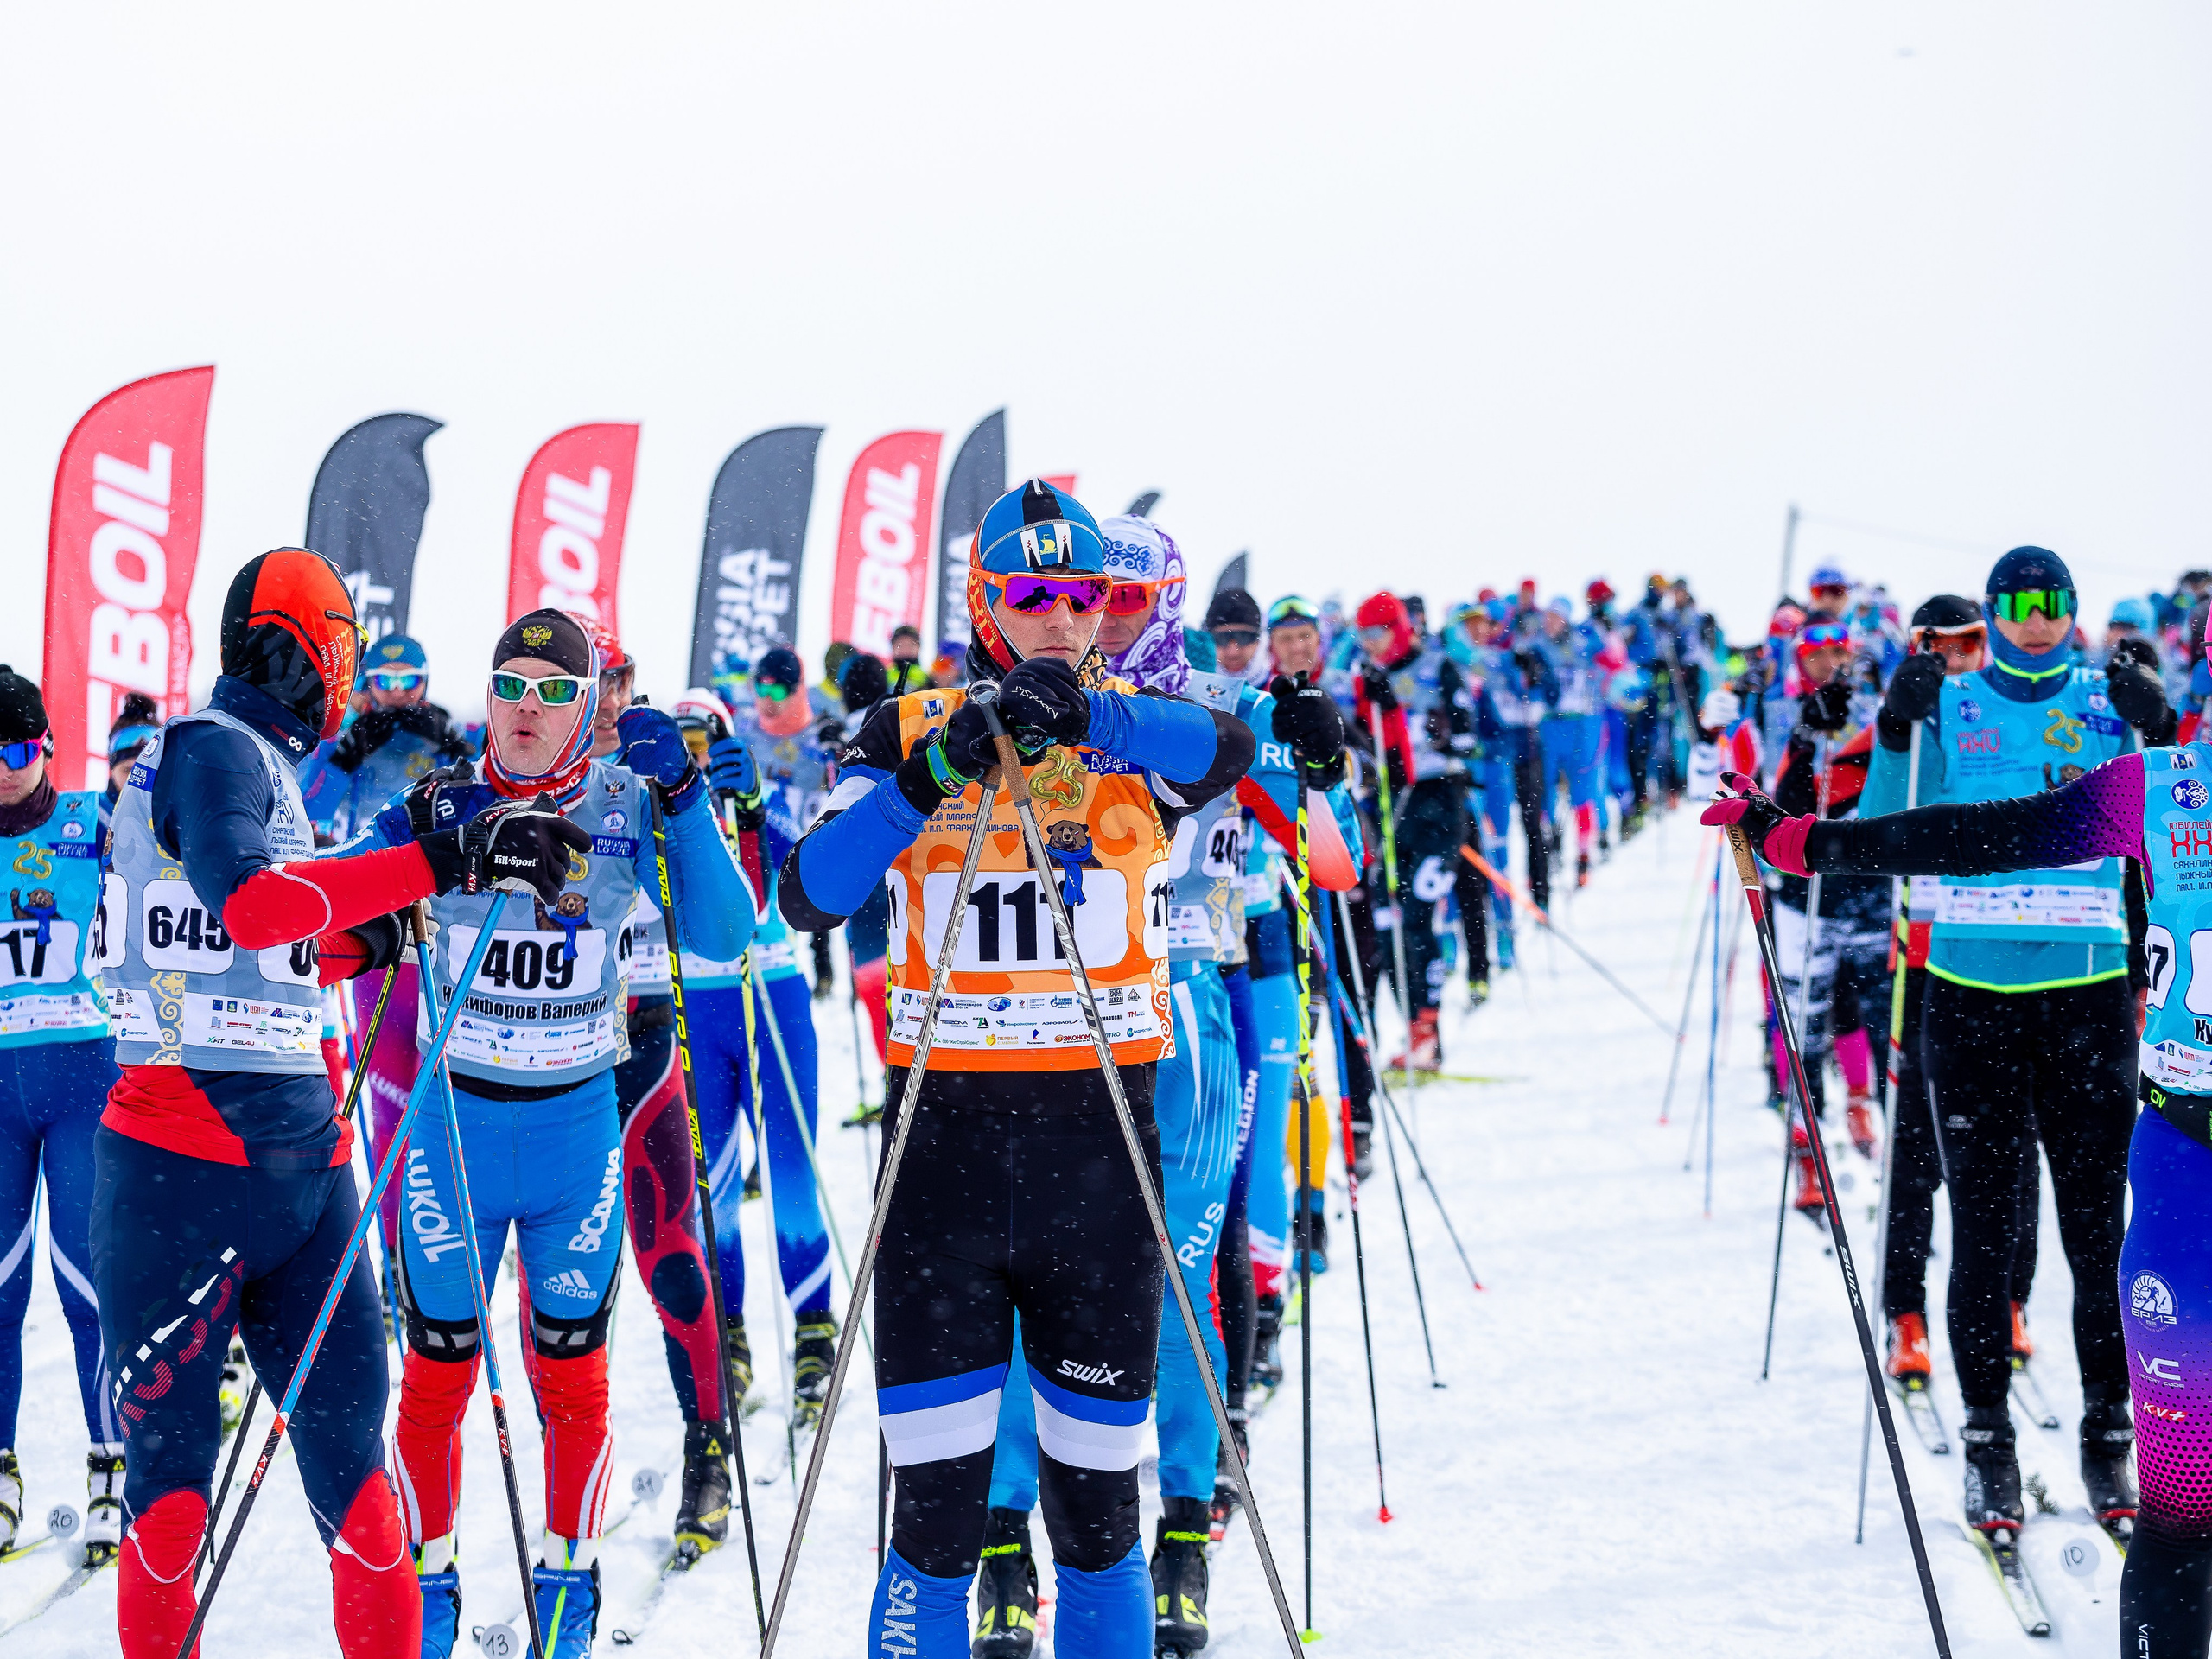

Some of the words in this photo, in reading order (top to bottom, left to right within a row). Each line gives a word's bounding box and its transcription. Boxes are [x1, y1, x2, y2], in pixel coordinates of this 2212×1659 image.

[485, 808, 511, 823] KV+
[946, 823, 1020, 834] ФАРХДИНОВА
[148, 905, 232, 952] 645
[967, 880, 1075, 962] 111
[480, 938, 576, 990] 409
[442, 982, 537, 1021] Нкифоров
[540, 992, 608, 1021] Валерий
[1063, 1033, 1091, 1042] ЭКОНОМ
[407, 1147, 467, 1263] LUKOIL
[567, 1146, 621, 1254] SCANIA
[543, 1278, 598, 1300] adidas
[2131, 1306, 2177, 1325] БРИЗ
[2143, 1402, 2188, 1421] KV+
[50, 1510, 73, 1529] 20
[486, 1633, 510, 1657] 13
